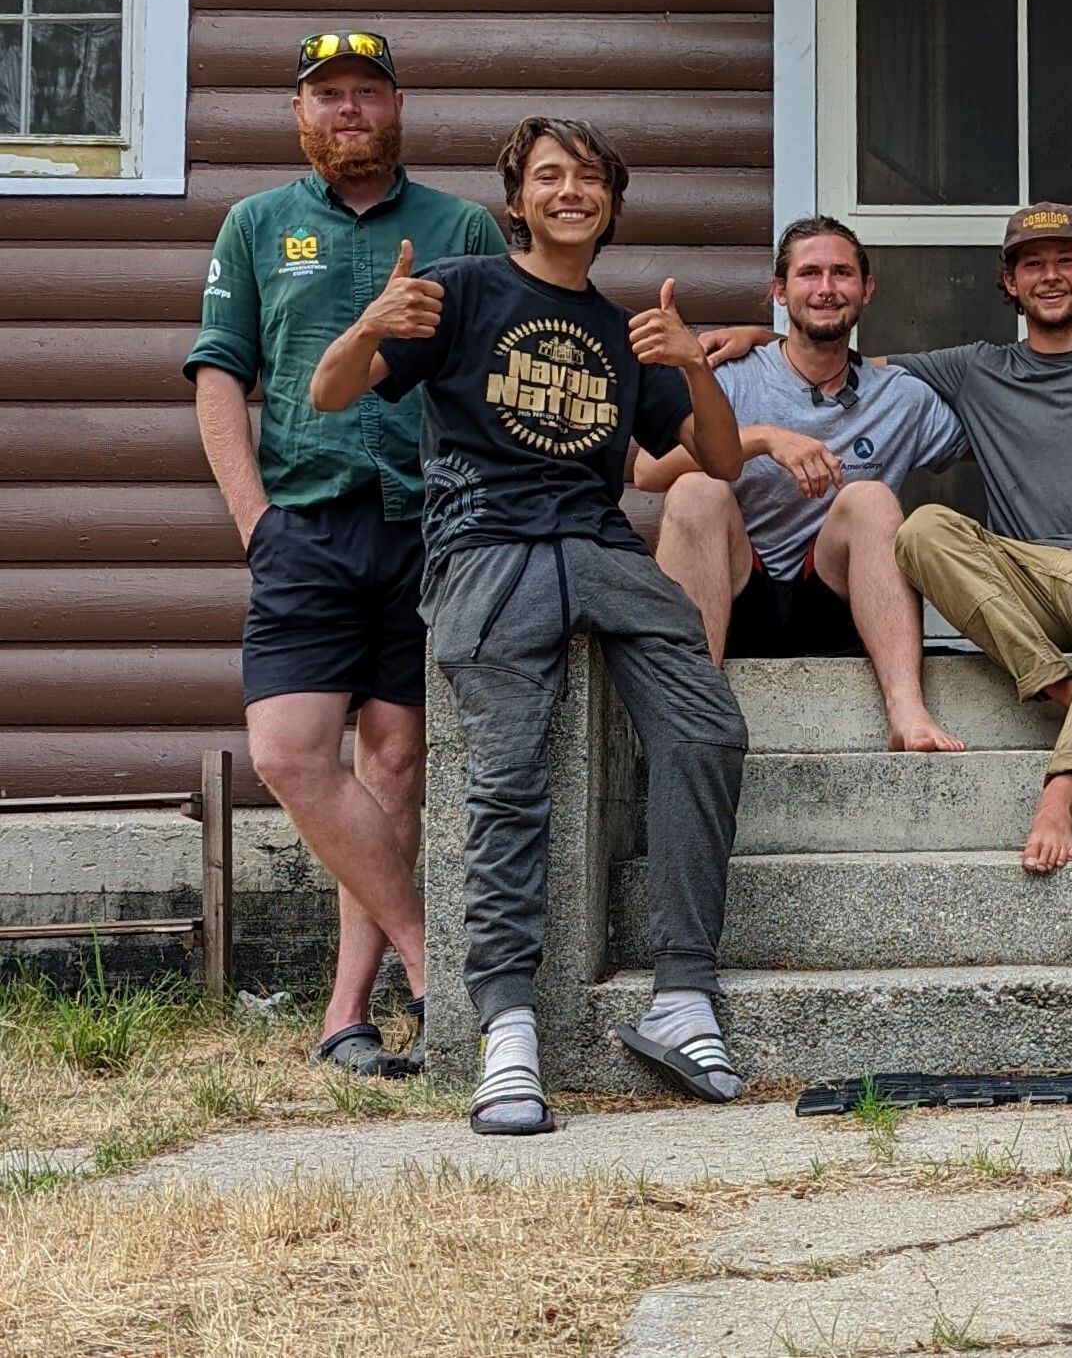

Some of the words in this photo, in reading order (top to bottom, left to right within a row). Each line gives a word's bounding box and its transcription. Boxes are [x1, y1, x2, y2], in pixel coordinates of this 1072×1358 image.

[1022, 211, 1070, 227] CORRIDOR
[485, 373, 619, 427] Nation
[508, 350, 608, 400] Navajo
